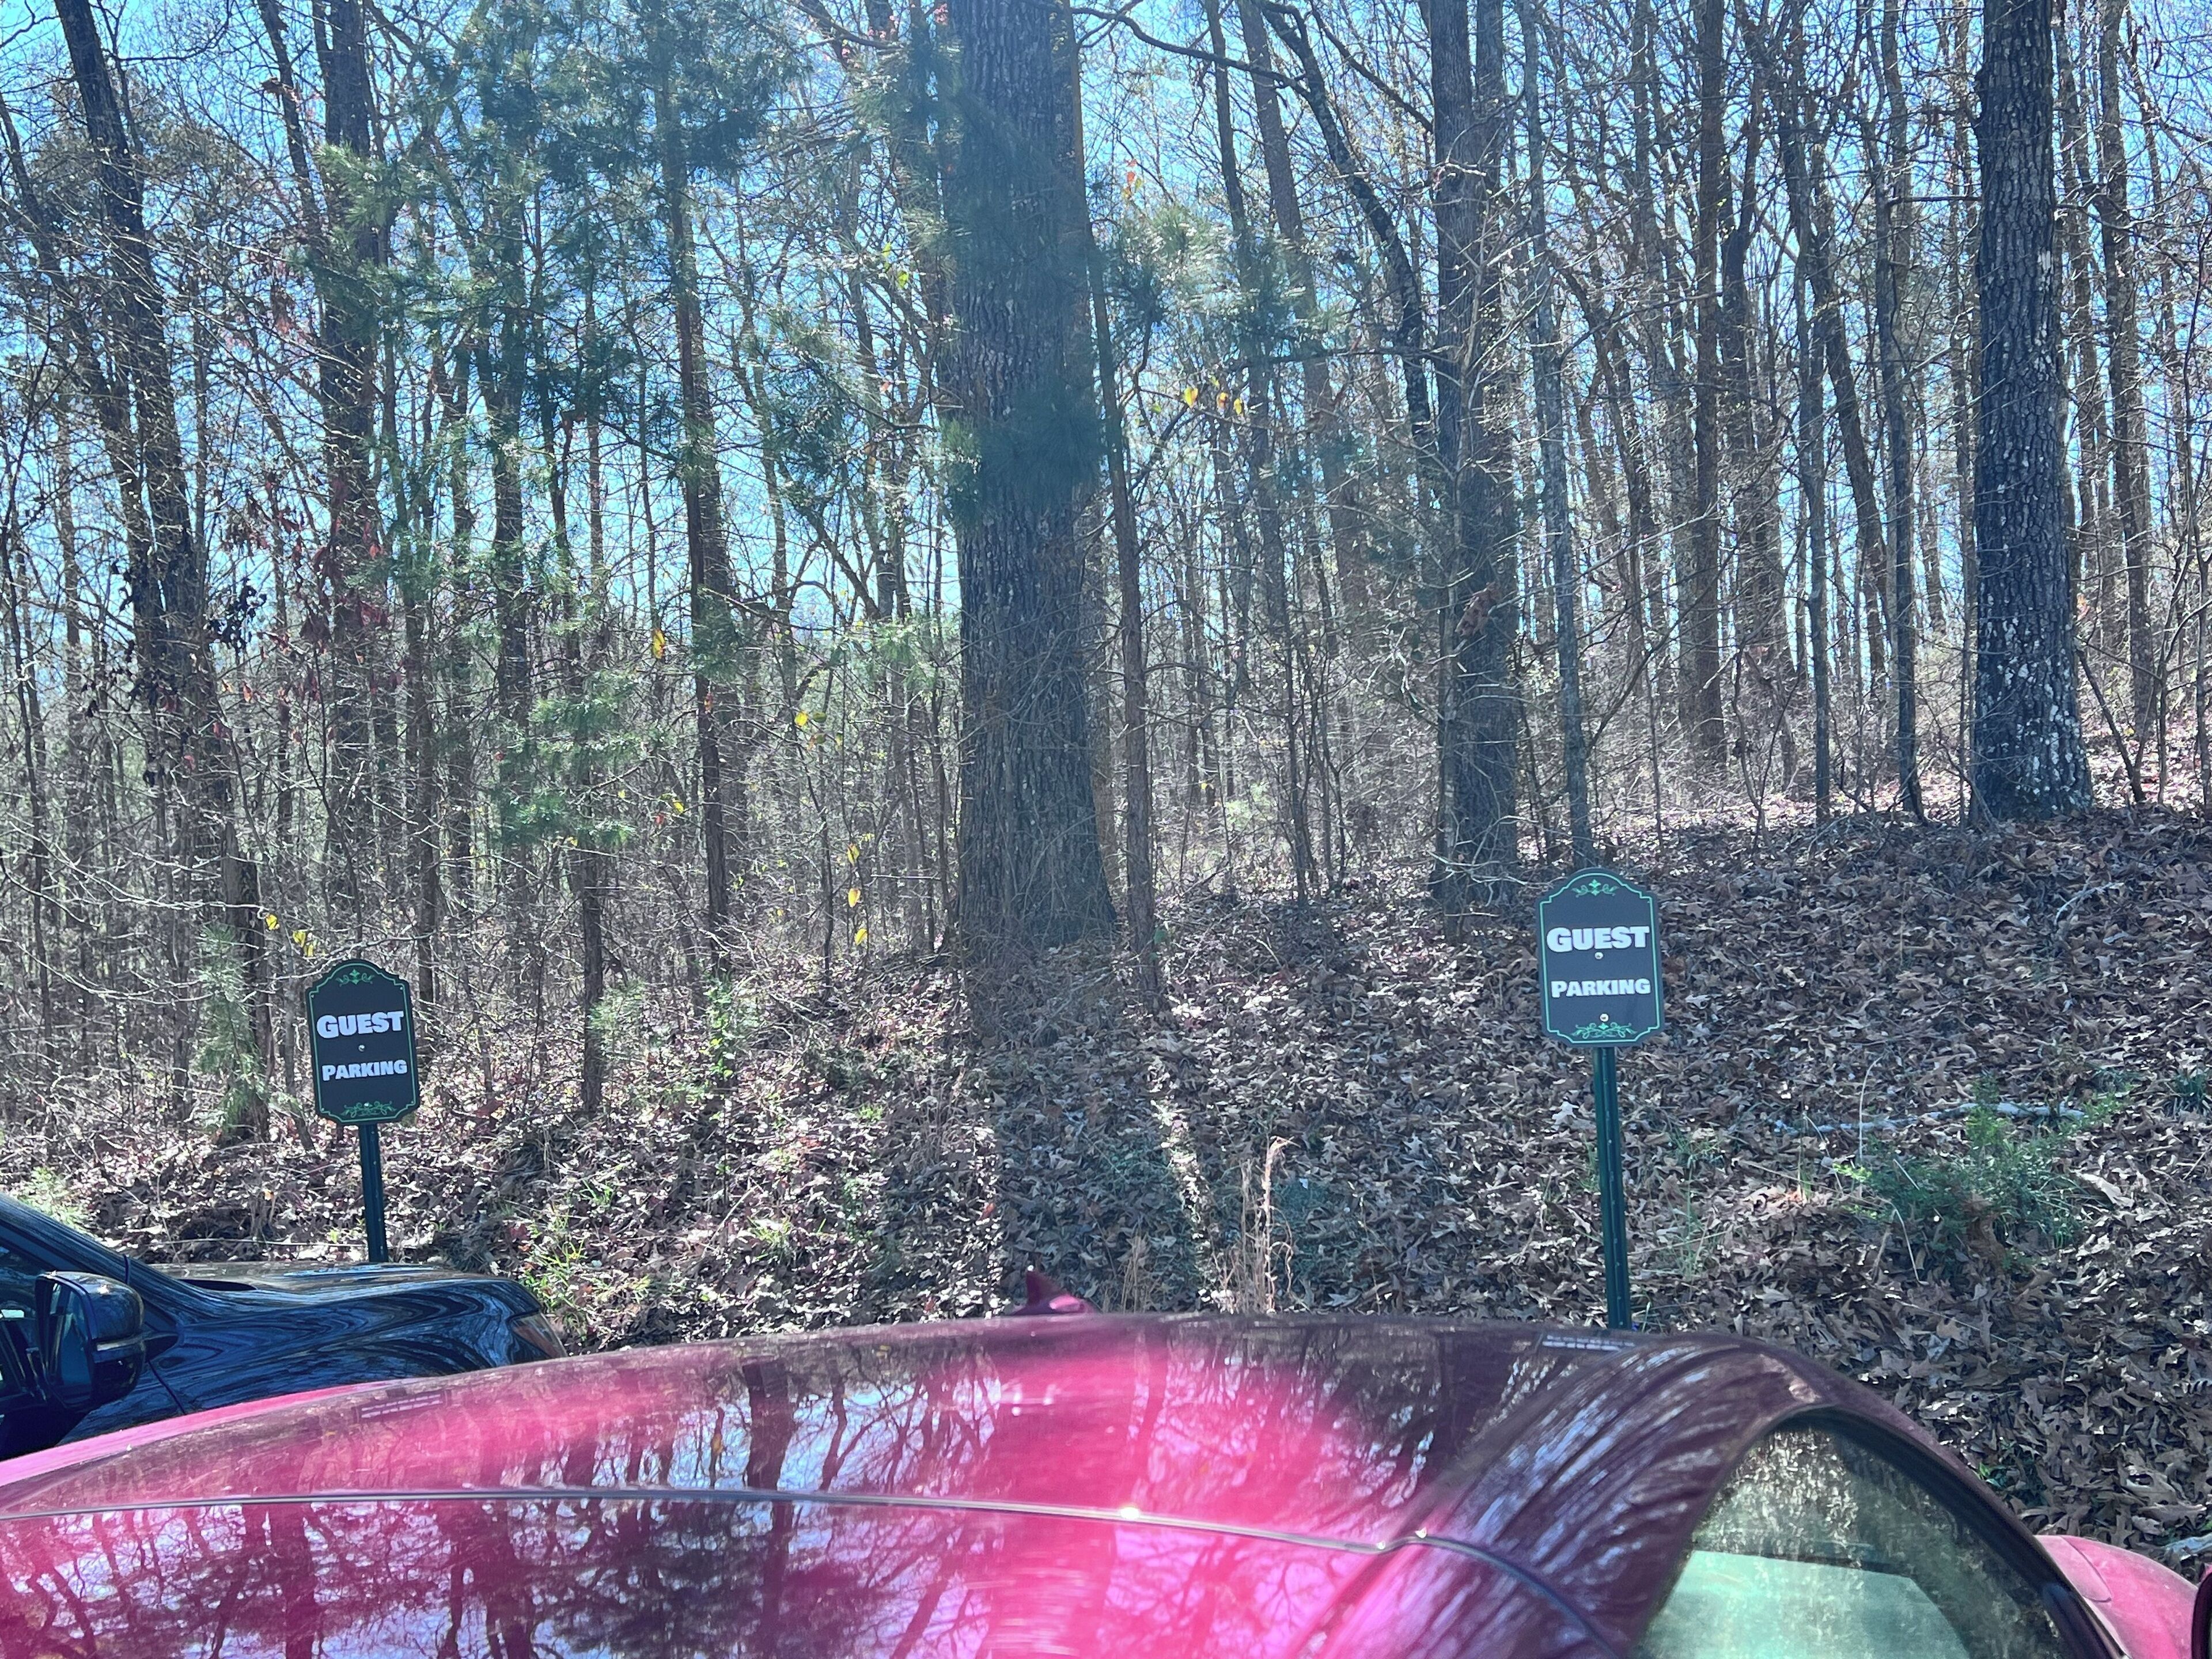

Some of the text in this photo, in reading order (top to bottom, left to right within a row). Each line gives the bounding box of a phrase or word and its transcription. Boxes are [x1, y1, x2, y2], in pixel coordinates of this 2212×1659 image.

[1547, 926, 1650, 952] GUEST
[1551, 979, 1650, 998] PARKING
[317, 1011, 404, 1038] GUEST
[322, 1060, 407, 1081] PARKING
